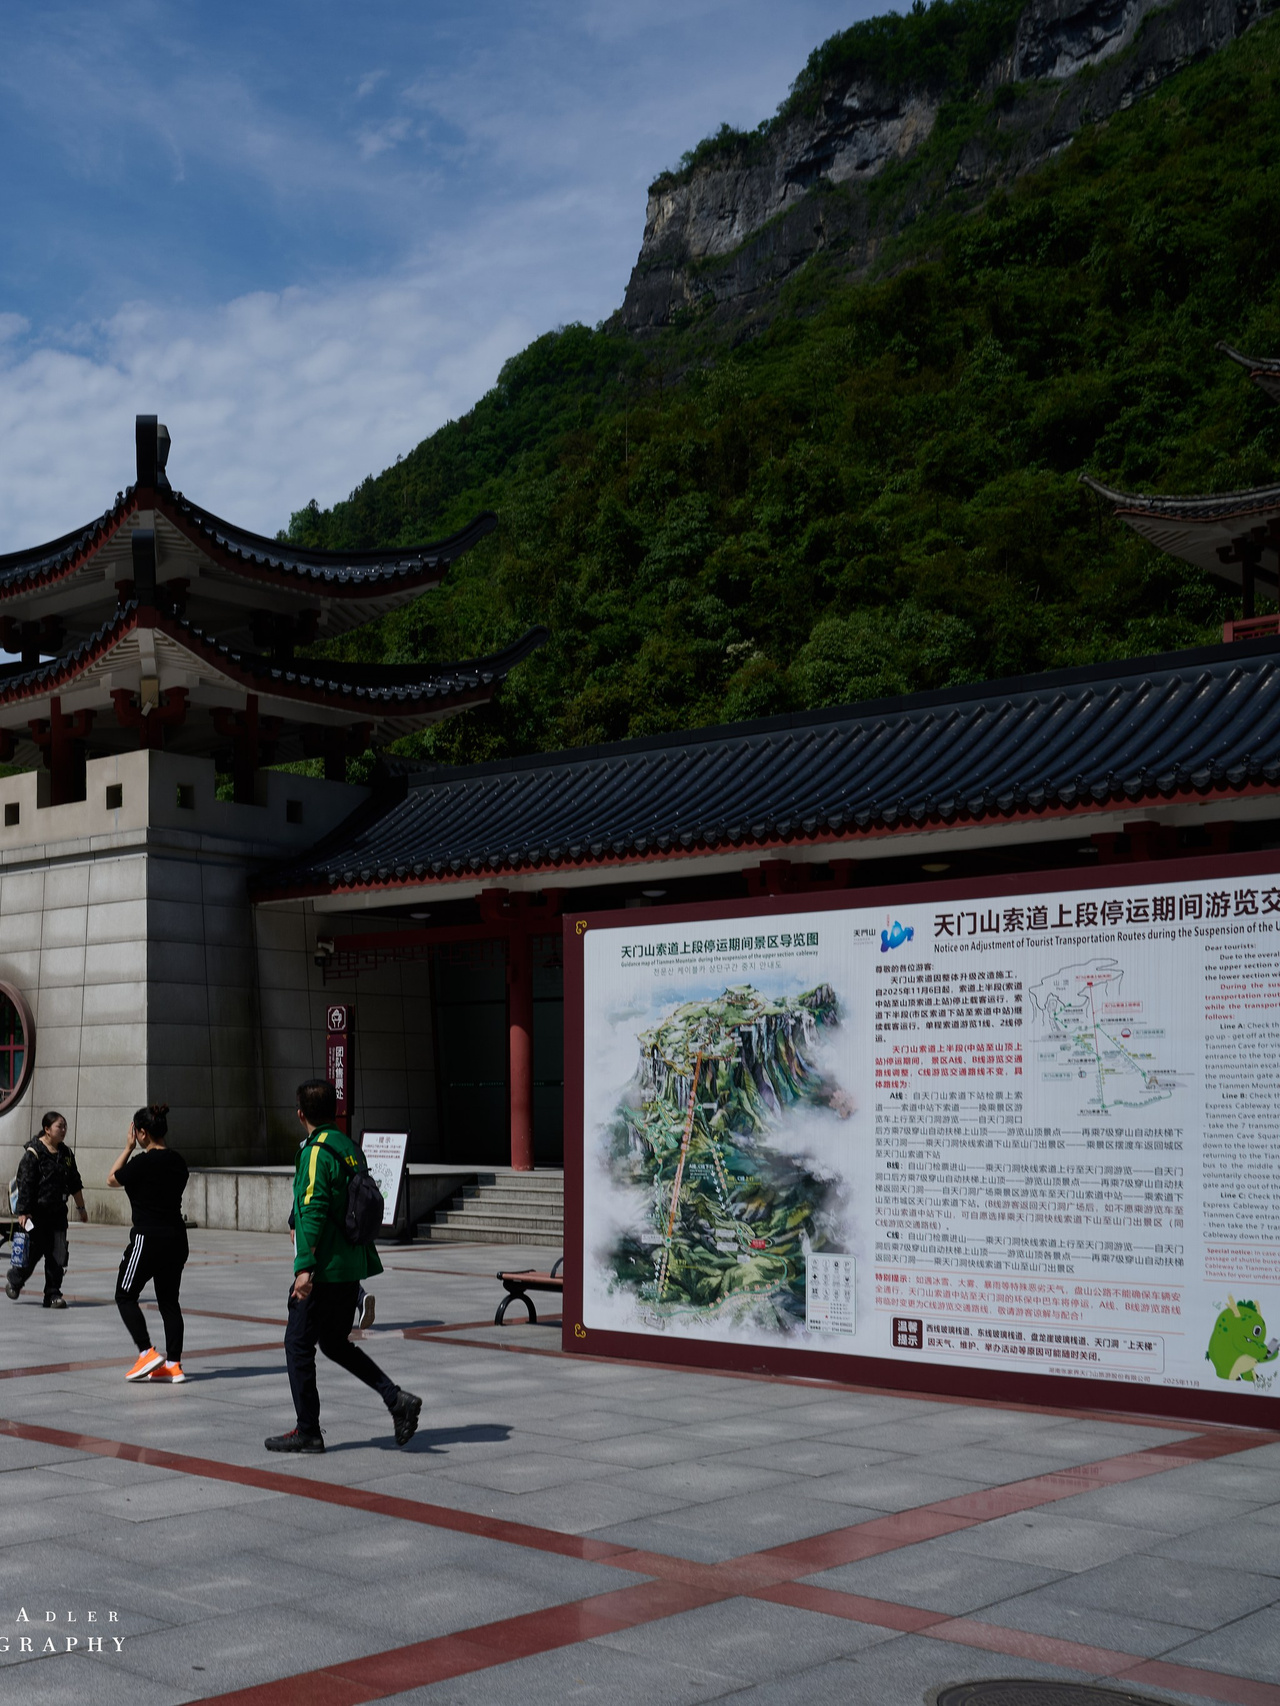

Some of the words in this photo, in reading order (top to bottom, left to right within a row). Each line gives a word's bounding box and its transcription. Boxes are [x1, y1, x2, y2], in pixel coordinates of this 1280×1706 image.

[934, 887, 1280, 937] 天门山索道上段停运期间游览交
[621, 932, 818, 958] 天门山索道上段停运期间景区导览图
[934, 943, 958, 953] Notice
[960, 943, 968, 951] on
[971, 939, 1014, 953] Adjustment
[1017, 938, 1024, 948] of
[1027, 936, 1053, 947] Tourist
[1055, 932, 1115, 947] Transportation
[1118, 931, 1145, 941] Routes
[1148, 929, 1175, 941] during
[1178, 927, 1192, 937] the
[1195, 923, 1244, 938] Suspension
[1247, 922, 1256, 933] of
[1259, 921, 1273, 932] the
[1203, 1231, 1237, 1239] Cableway
[1239, 1232, 1259, 1240] down
[898, 1334, 918, 1346] 提示
